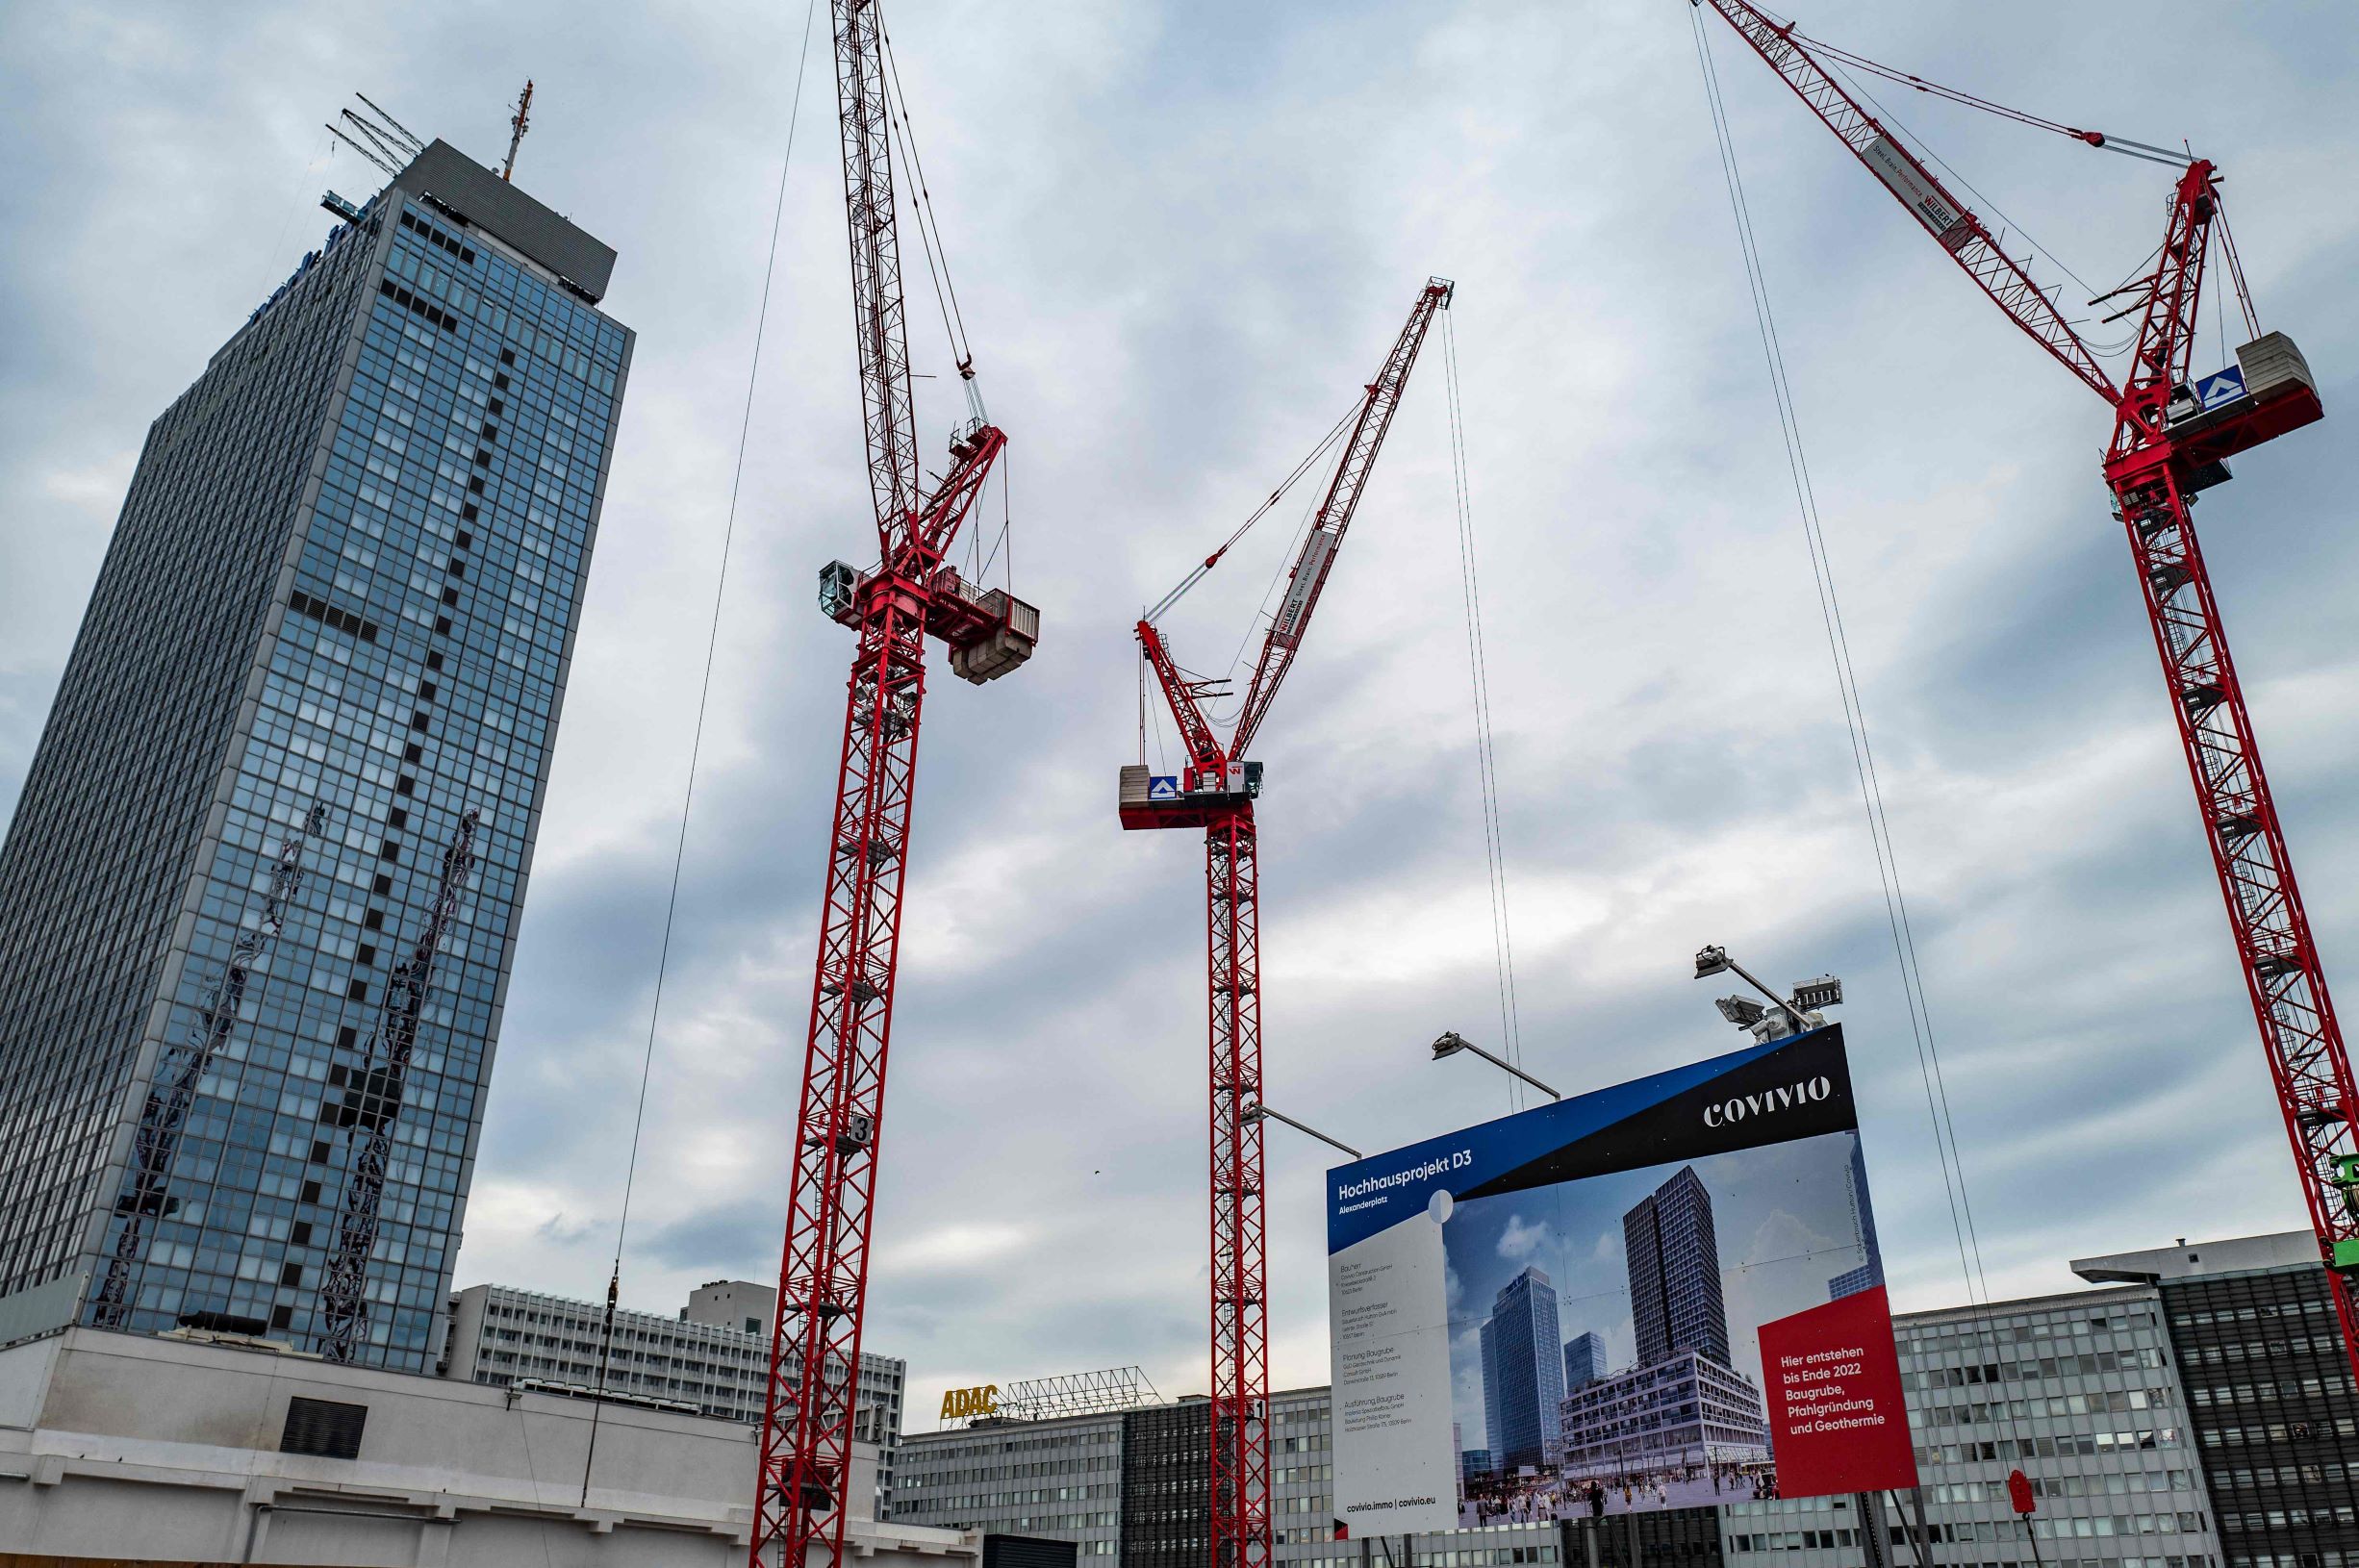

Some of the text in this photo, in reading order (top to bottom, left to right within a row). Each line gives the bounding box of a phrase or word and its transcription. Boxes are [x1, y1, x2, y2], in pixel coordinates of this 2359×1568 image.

[1924, 195, 1954, 226] WILBERT
[1281, 598, 1298, 632] WILBERT
[855, 1117, 868, 1141] 3
[1338, 1150, 1472, 1201] Hochhausprojekt D3
[1339, 1196, 1388, 1215] Alexanderplatz
[1366, 1347, 1394, 1358] Baugrube
[1781, 1348, 1864, 1367] Hier entstehen
[1784, 1363, 1862, 1384] bis Ende 2022
[940, 1384, 998, 1419] ADAC
[1786, 1385, 1845, 1401] Baugrube,
[1256, 1401, 1263, 1418] 1
[1788, 1399, 1874, 1418] Pfahlgründung
[1790, 1413, 1885, 1435] und Geothermie
[1347, 1501, 1393, 1513] covivio.immo
[1399, 1496, 1436, 1507] covivio.eu
